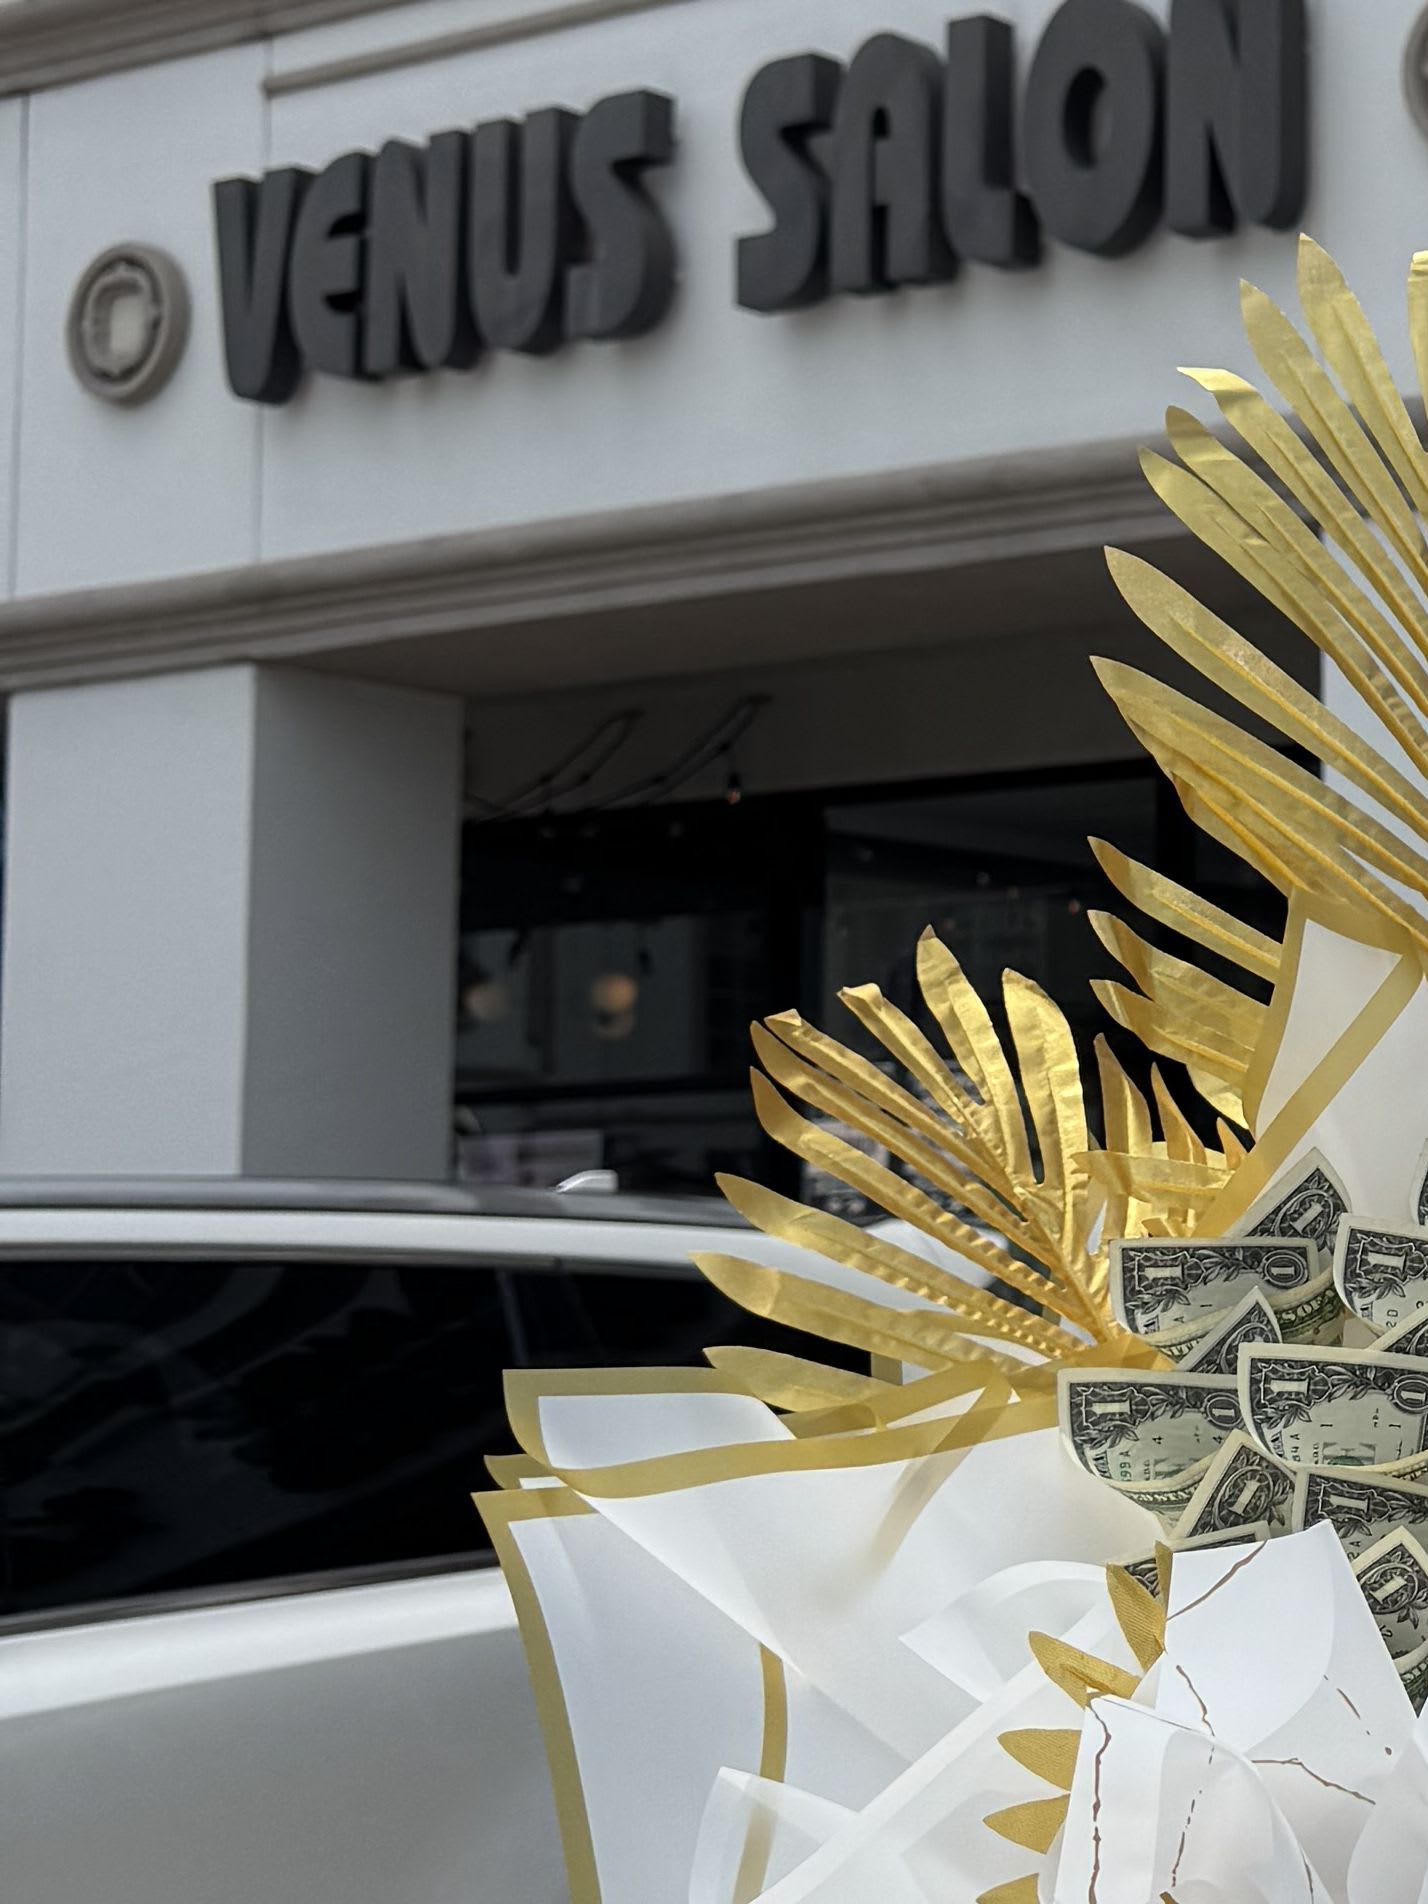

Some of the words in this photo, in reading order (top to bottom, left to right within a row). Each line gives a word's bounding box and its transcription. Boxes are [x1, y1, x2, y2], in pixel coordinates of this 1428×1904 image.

[212, 90, 678, 406] VENUS
[1290, 1202, 1324, 1232] 1
[1367, 1253, 1407, 1267] 1
[1143, 1265, 1182, 1278] 1
[1269, 1378, 1311, 1394] 1
[1090, 1402, 1132, 1415] 1
[1151, 1435, 1164, 1445] 4
[1227, 1478, 1261, 1517] 1
[1328, 1496, 1369, 1512] 1
[1372, 1575, 1408, 1604] 1
